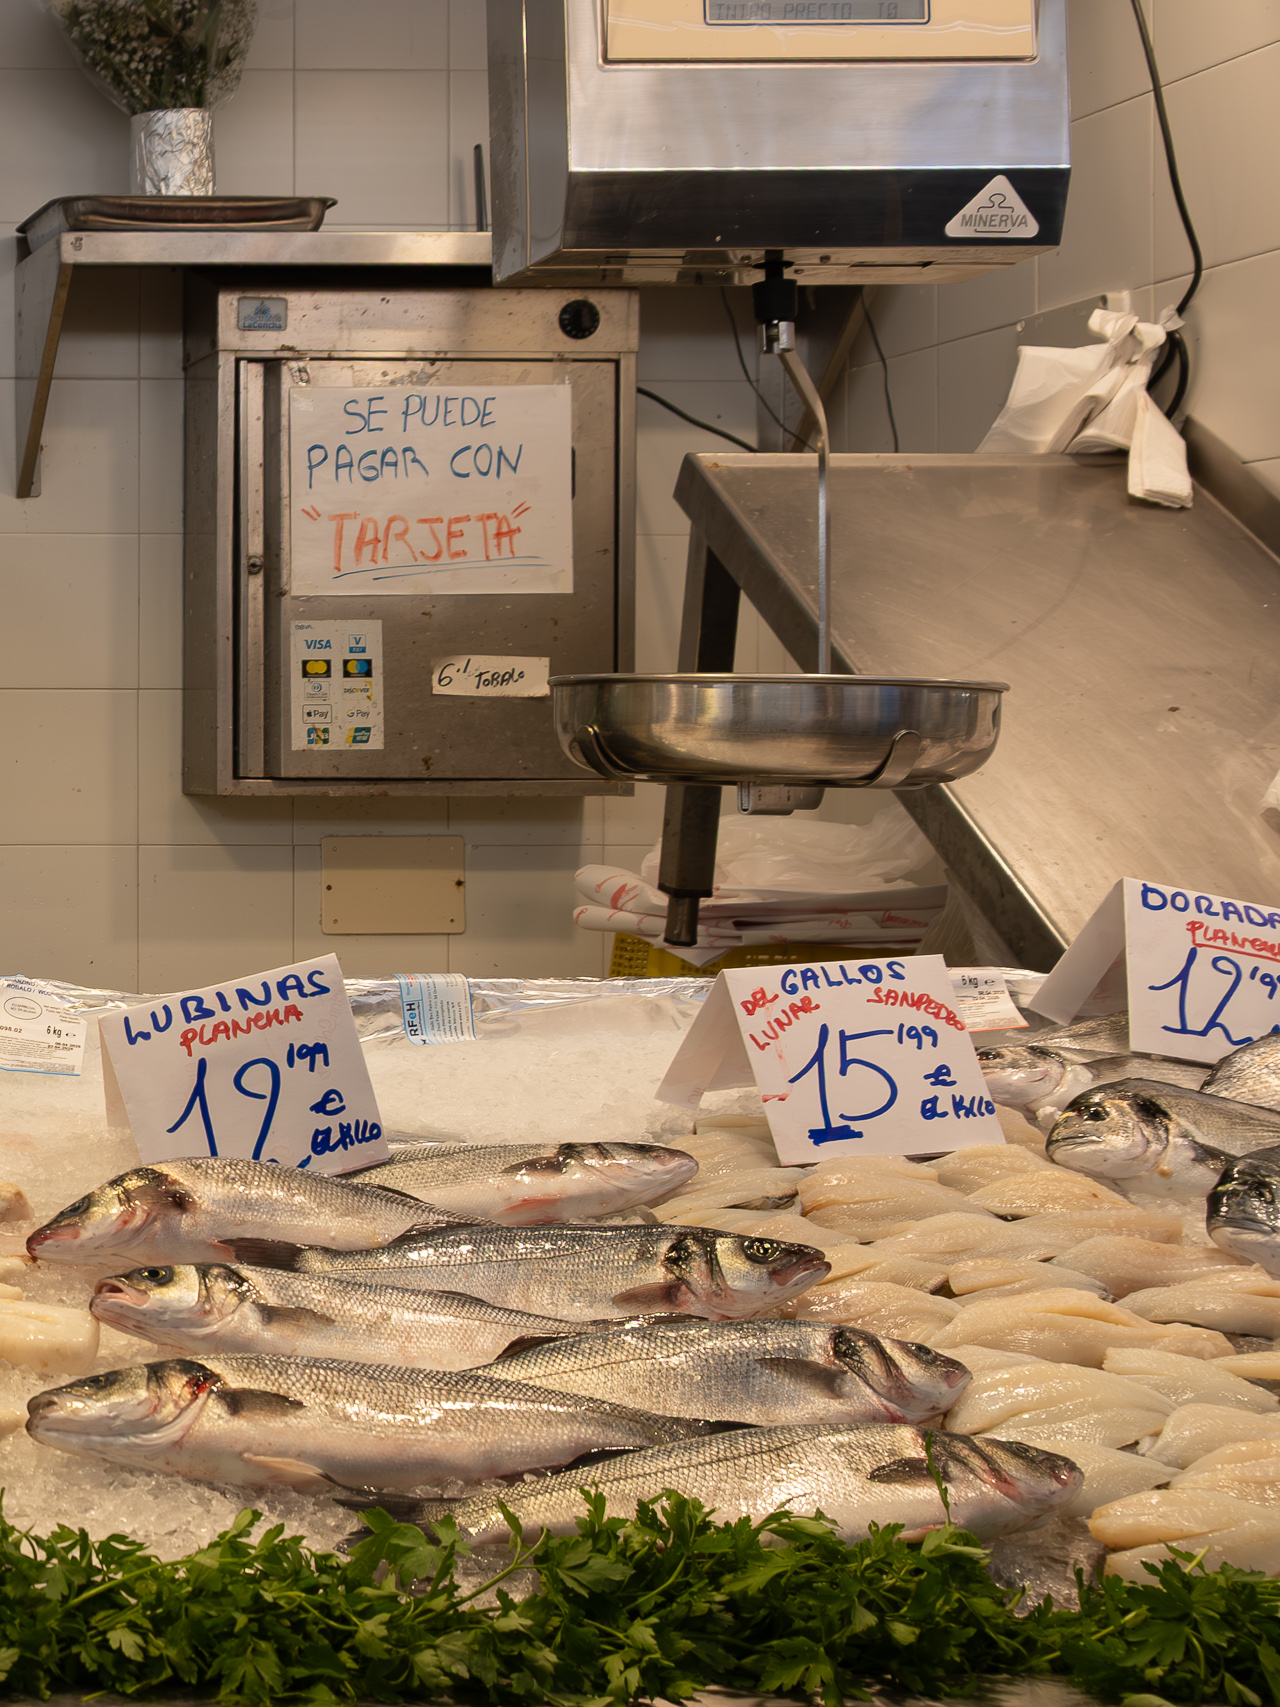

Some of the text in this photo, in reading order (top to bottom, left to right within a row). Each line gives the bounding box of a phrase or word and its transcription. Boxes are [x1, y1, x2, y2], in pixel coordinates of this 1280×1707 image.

[960, 213, 1028, 228] MINERVA
[343, 394, 496, 435] SE PUEDE
[307, 443, 523, 489] PAGAR CON
[304, 639, 332, 649] VISA
[313, 710, 328, 719] Pay
[781, 961, 906, 995] GALLOS
[961, 975, 978, 988] 6 kg
[123, 970, 331, 1045] LUBINAS
[406, 1002, 419, 1037] RFeH
[46, 1025, 62, 1038] 6 kg
